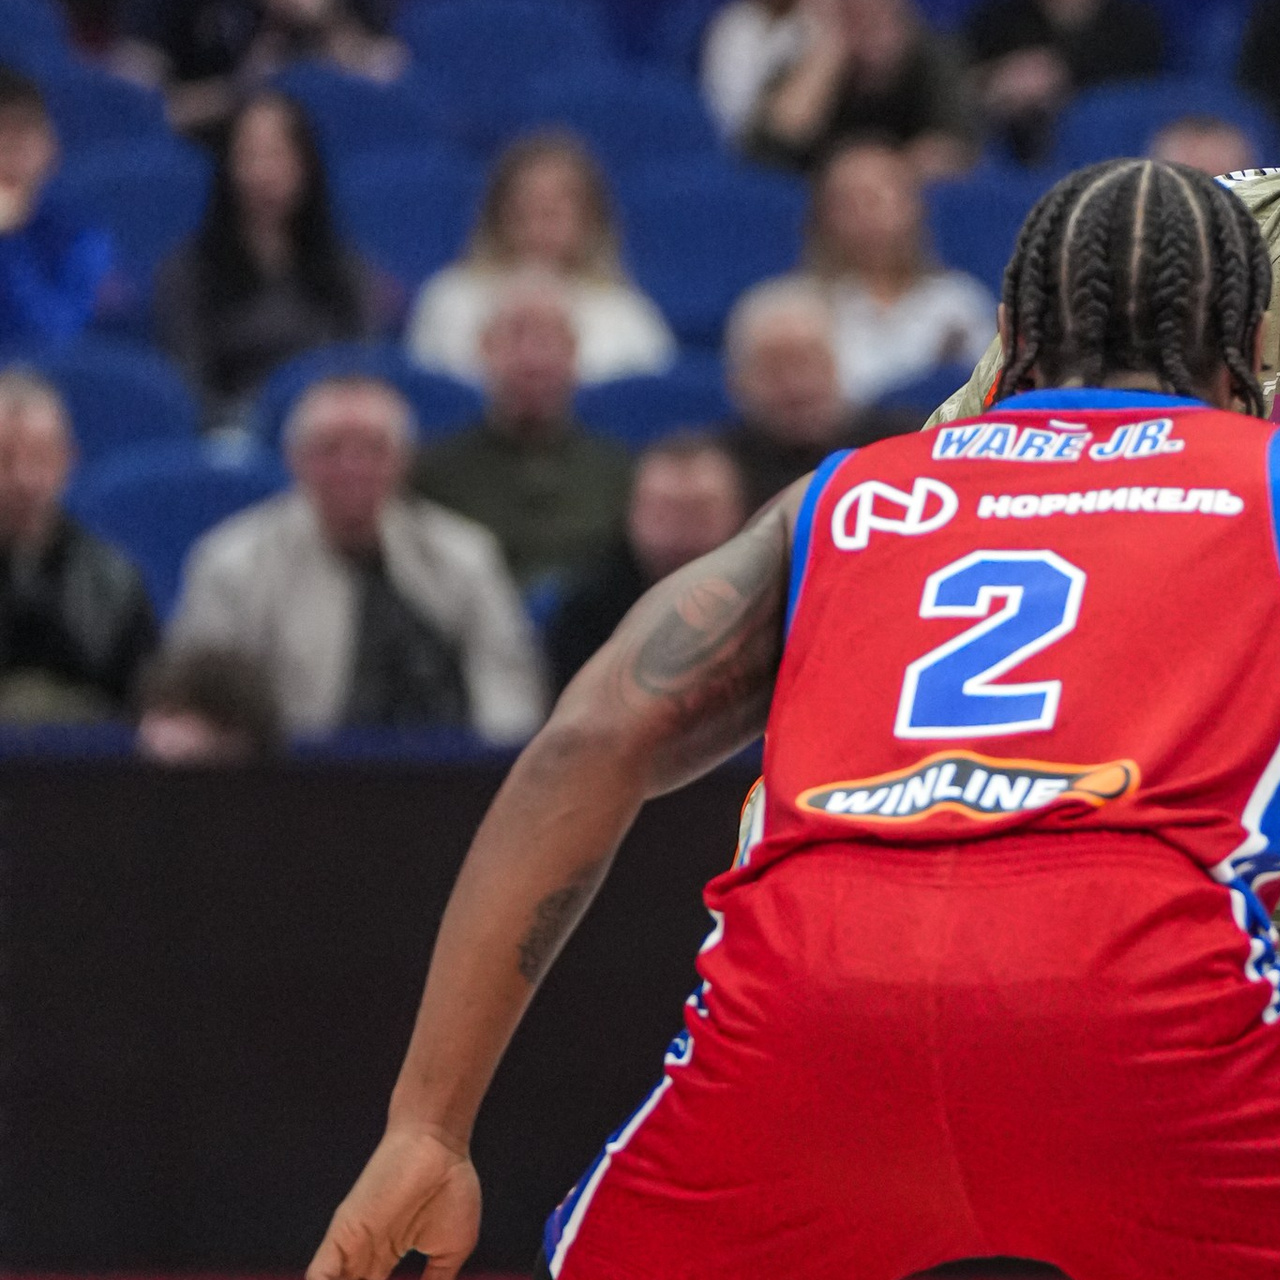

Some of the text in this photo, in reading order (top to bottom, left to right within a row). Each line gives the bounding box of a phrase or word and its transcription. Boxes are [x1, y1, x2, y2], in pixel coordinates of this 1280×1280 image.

[932, 418, 1186, 462] WARE JR.
[977, 487, 1244, 519] НОРНИКЕЛЬ
[893, 549, 1087, 740] 2
[824, 762, 1072, 818] WINLINE
